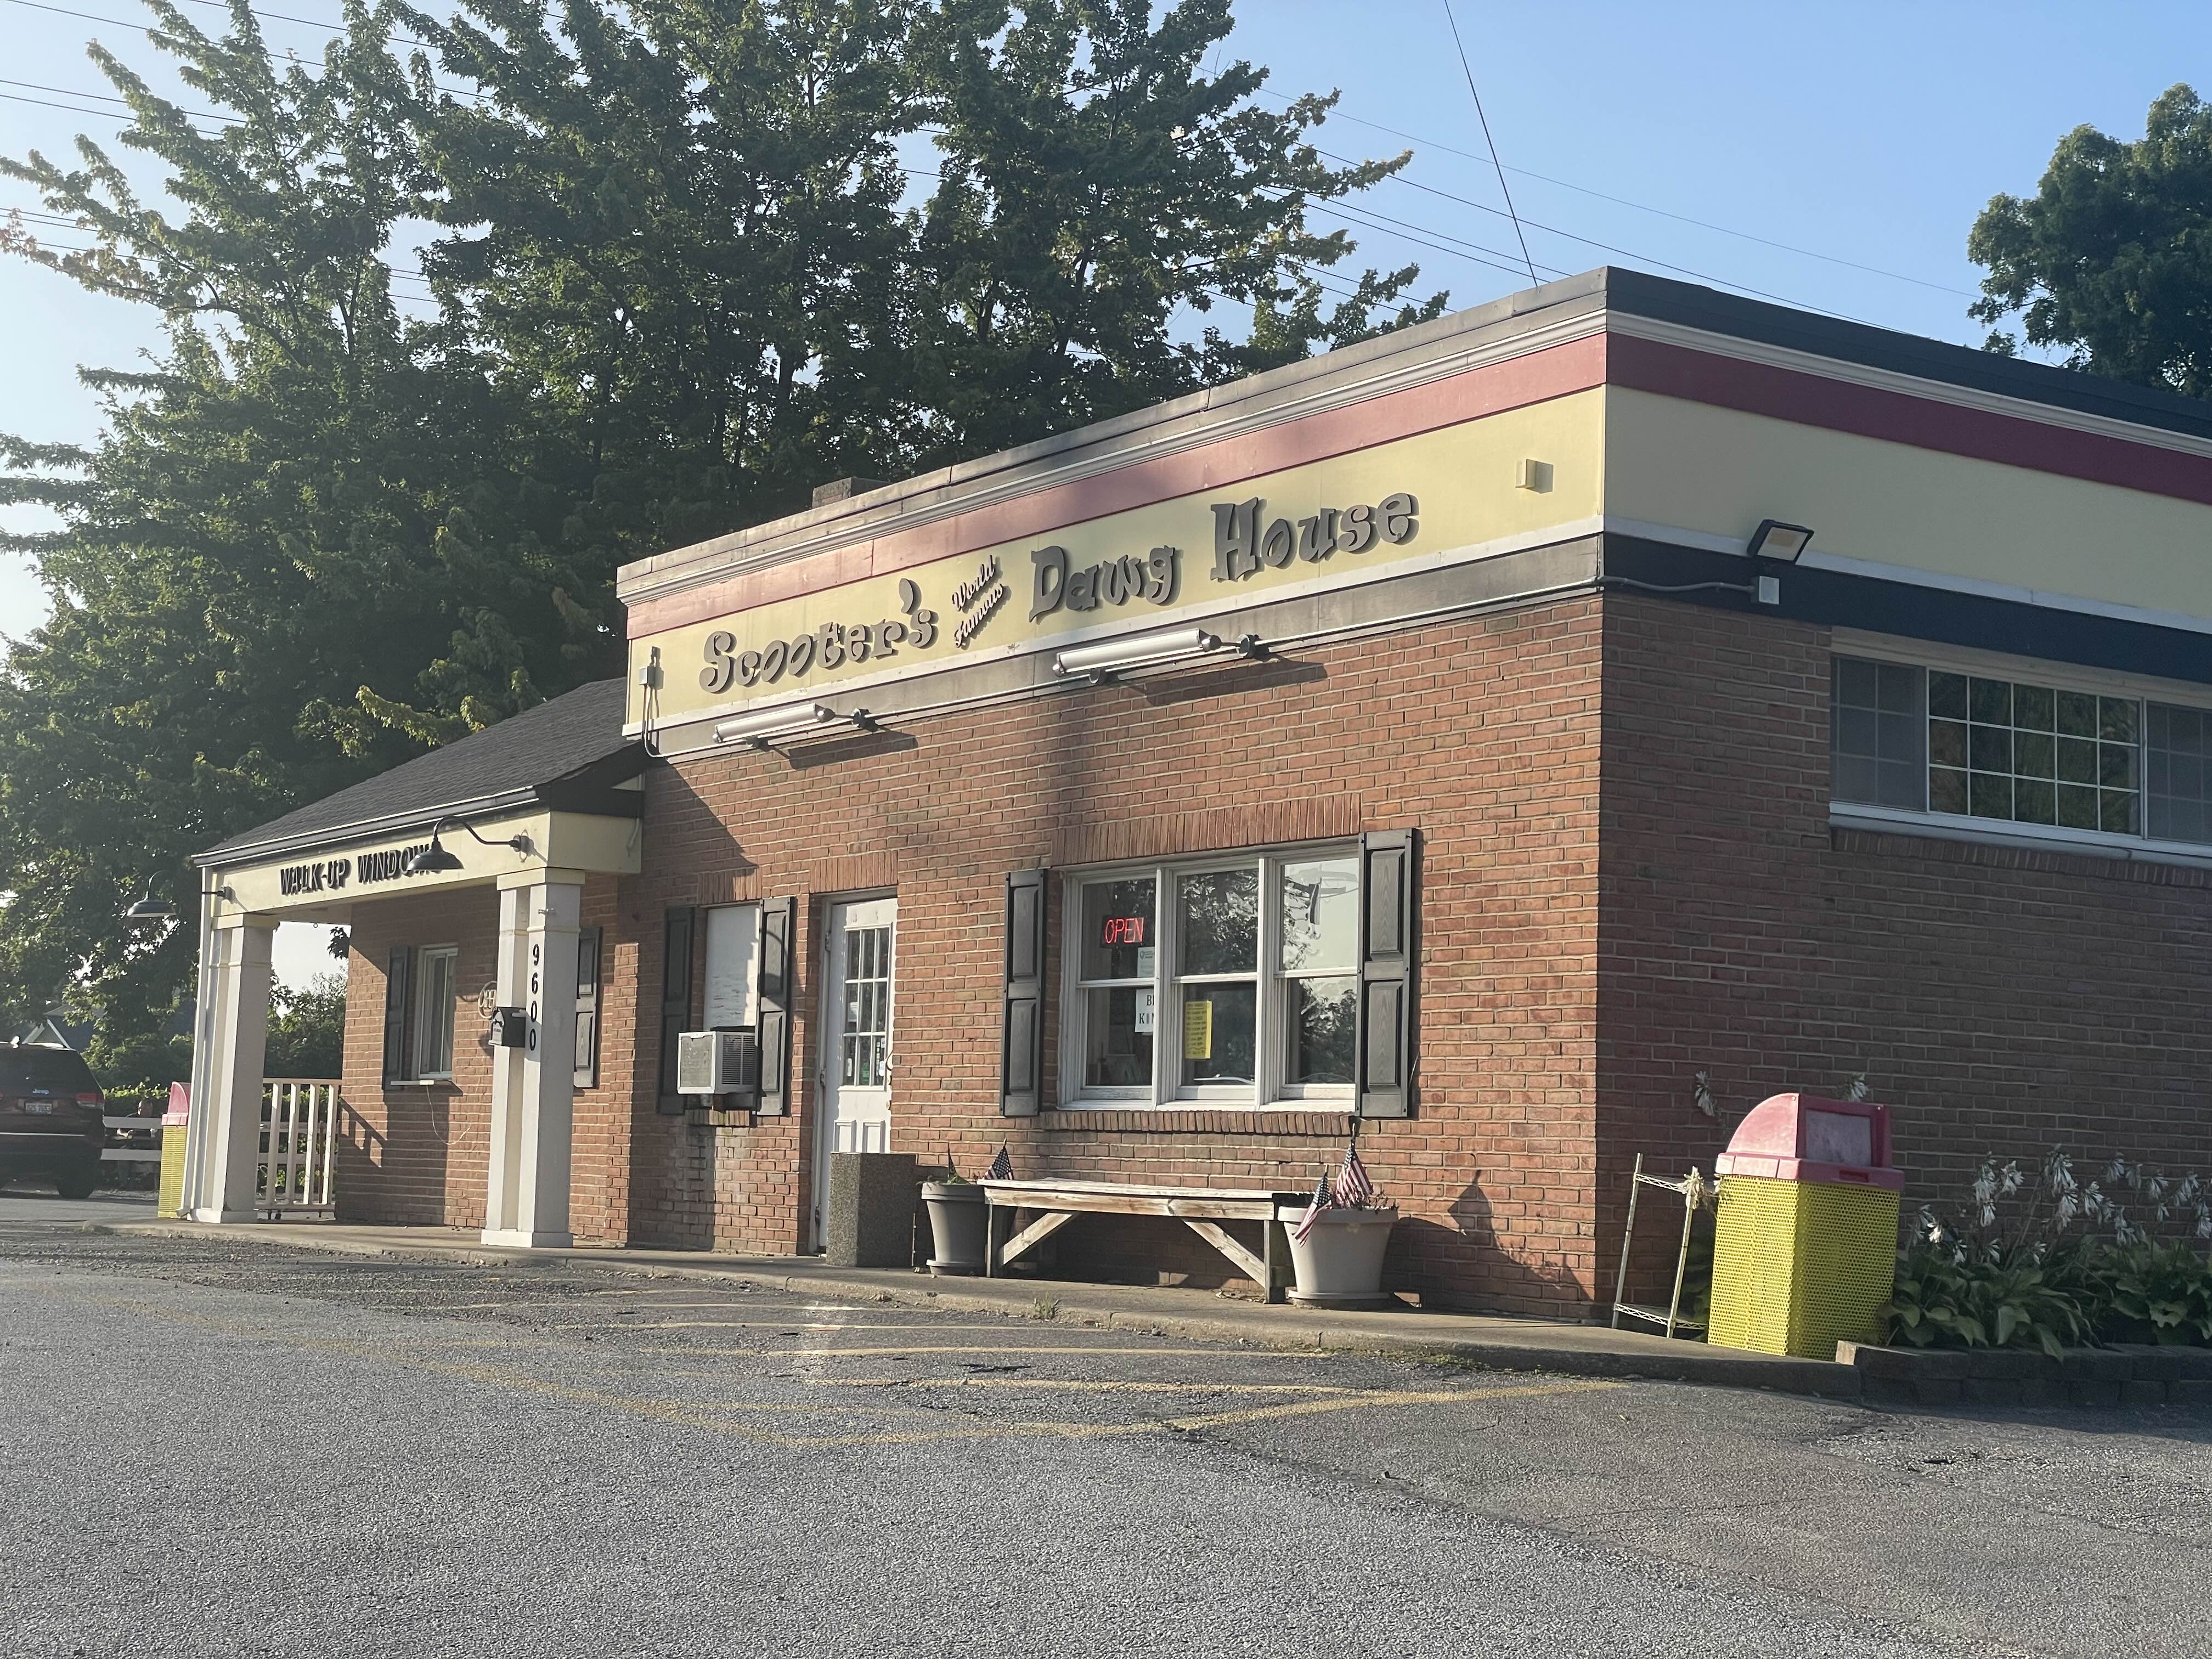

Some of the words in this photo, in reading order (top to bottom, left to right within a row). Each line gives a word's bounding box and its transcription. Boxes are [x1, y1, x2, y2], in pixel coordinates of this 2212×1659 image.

[699, 578, 936, 694] Scooter's
[1029, 545, 1177, 623] Dawg
[1210, 492, 1414, 583] House
[952, 555, 996, 612] World
[954, 583, 1005, 648] Famous
[280, 859, 351, 896] WALK-UP
[1105, 917, 1144, 944] OPEN
[529, 944, 540, 1051] 9600
